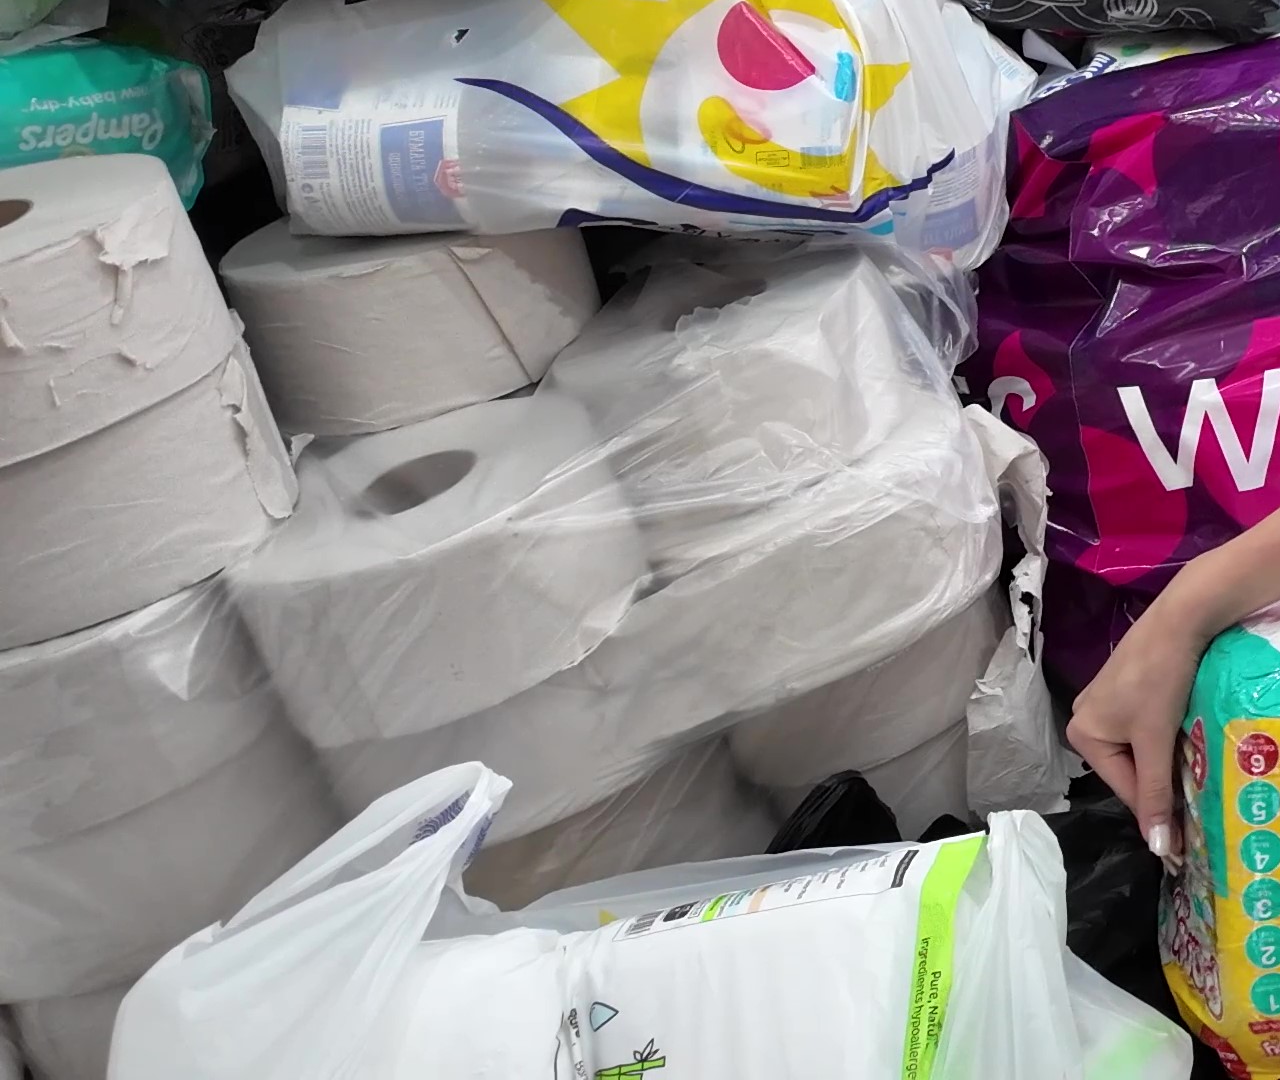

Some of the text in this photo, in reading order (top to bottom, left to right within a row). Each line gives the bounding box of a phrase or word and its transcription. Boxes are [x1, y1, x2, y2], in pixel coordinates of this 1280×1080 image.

[18, 107, 165, 152] Pampers
[409, 130, 426, 173] БУМАГА
[1250, 753, 1267, 774] 6
[1251, 801, 1267, 821] 5
[1254, 851, 1271, 870] 4
[1256, 898, 1273, 920] 3
[1261, 945, 1277, 966] 2
[930, 970, 943, 1005] Pure,
[1267, 994, 1280, 1013] 1
